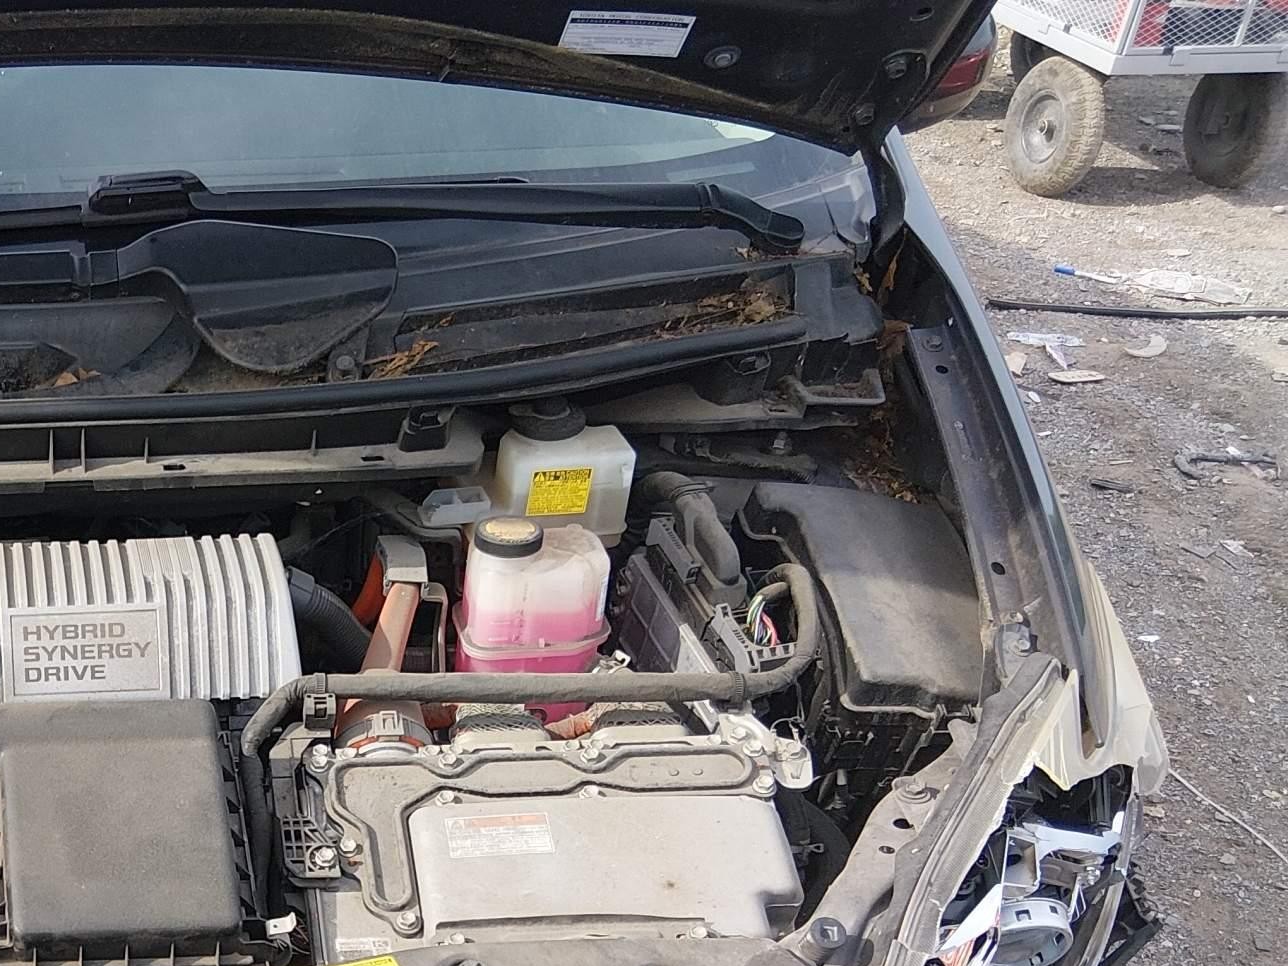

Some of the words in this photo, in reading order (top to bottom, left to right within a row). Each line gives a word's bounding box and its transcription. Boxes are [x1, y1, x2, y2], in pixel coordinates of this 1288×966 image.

[23, 622, 126, 642] HYBRID
[23, 641, 152, 663] SYNERGY
[24, 664, 107, 683] DRIVE
